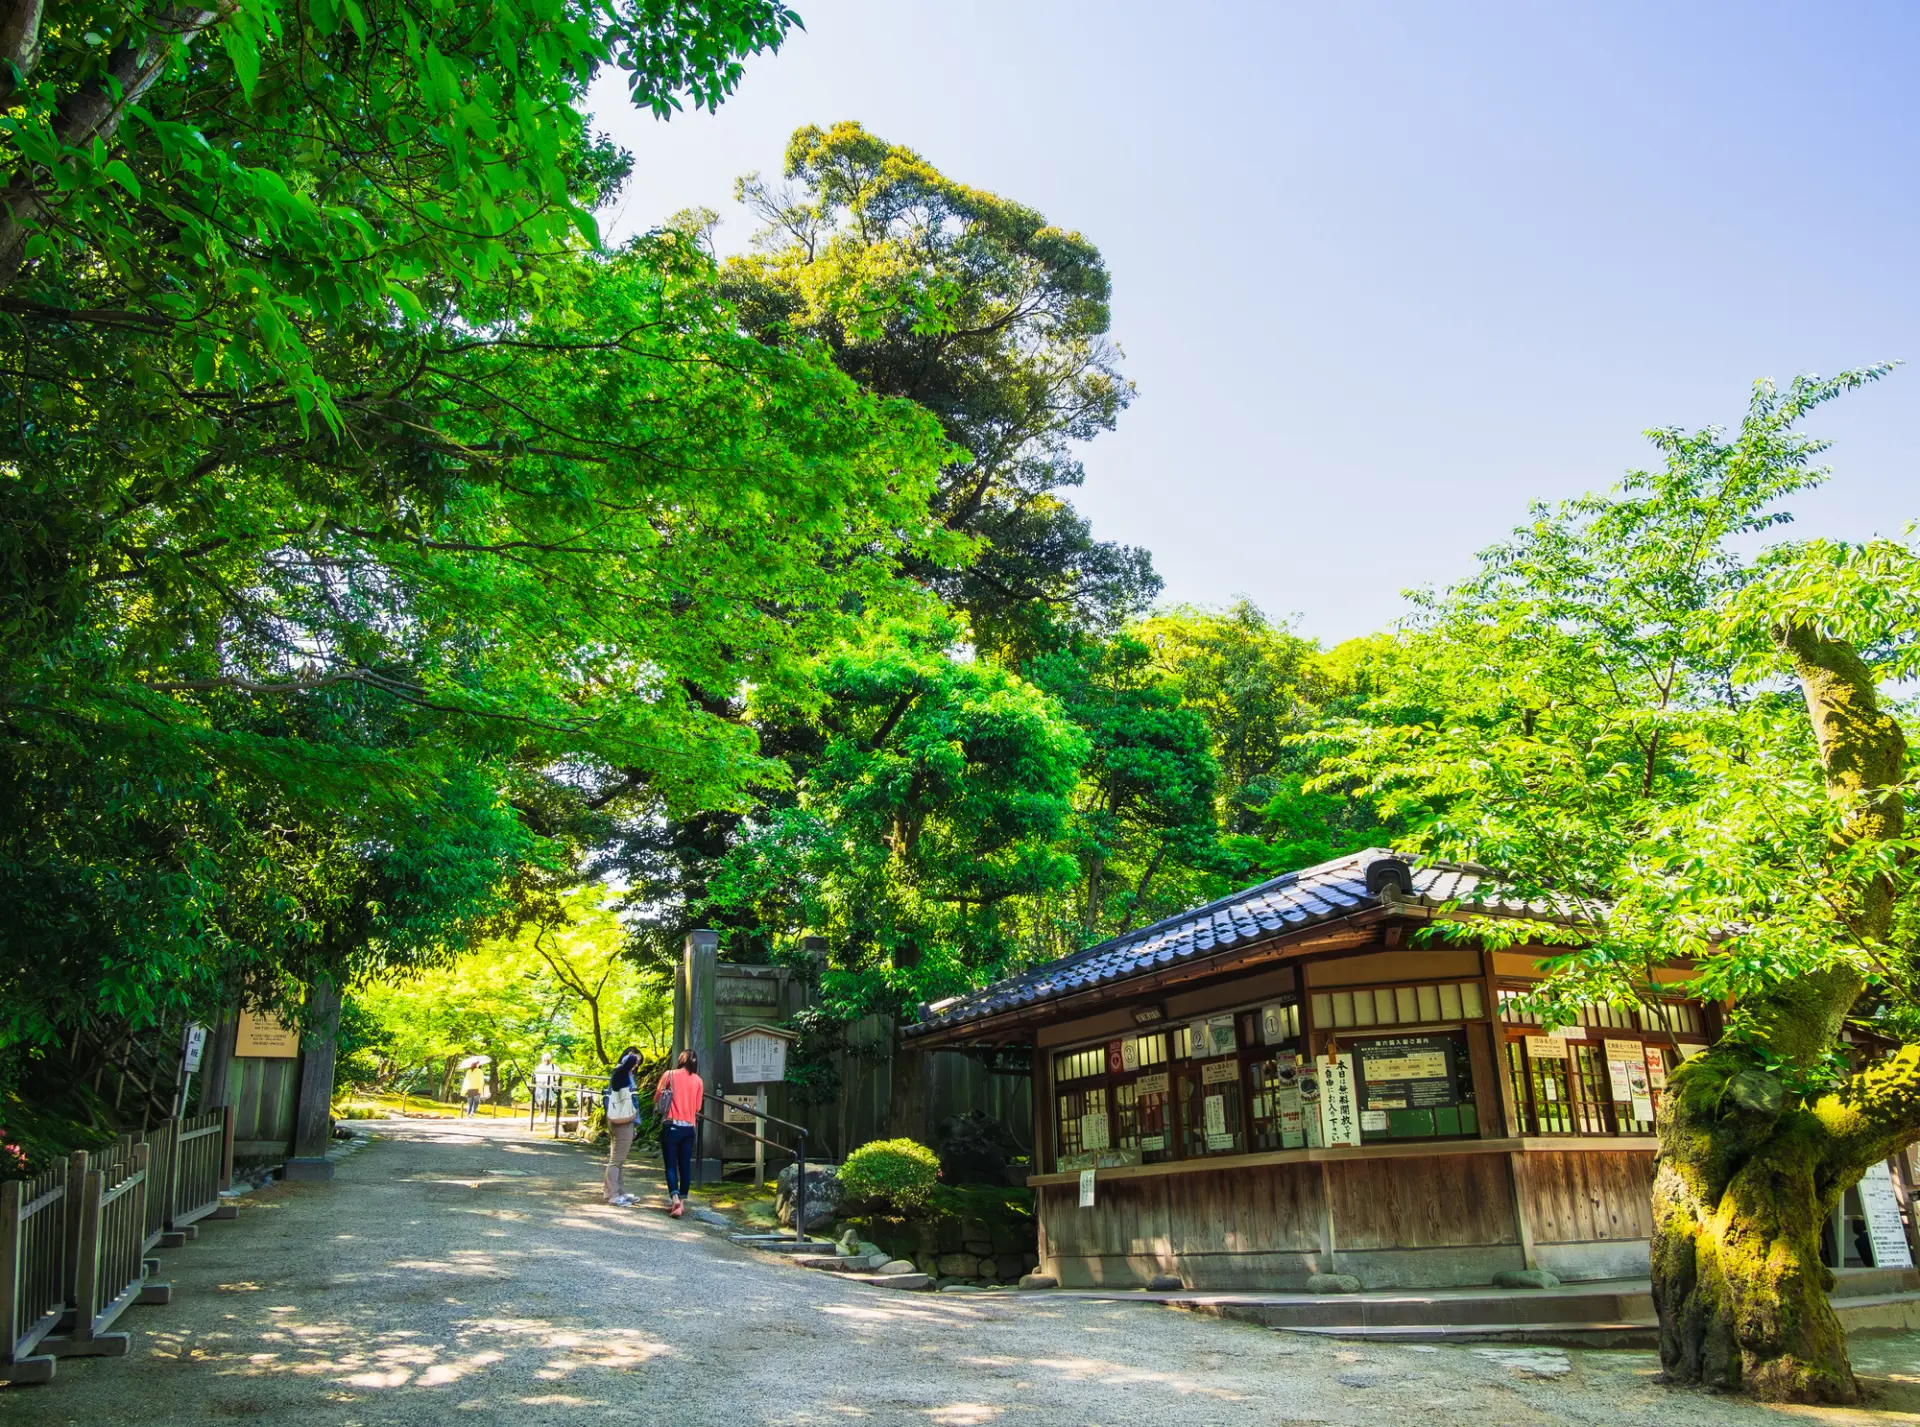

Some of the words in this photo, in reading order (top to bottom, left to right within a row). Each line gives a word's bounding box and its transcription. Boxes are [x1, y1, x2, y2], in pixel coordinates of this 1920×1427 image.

[190, 1031, 202, 1058] 桂坂
[1336, 1060, 1353, 1140] 本日は無料開放です
